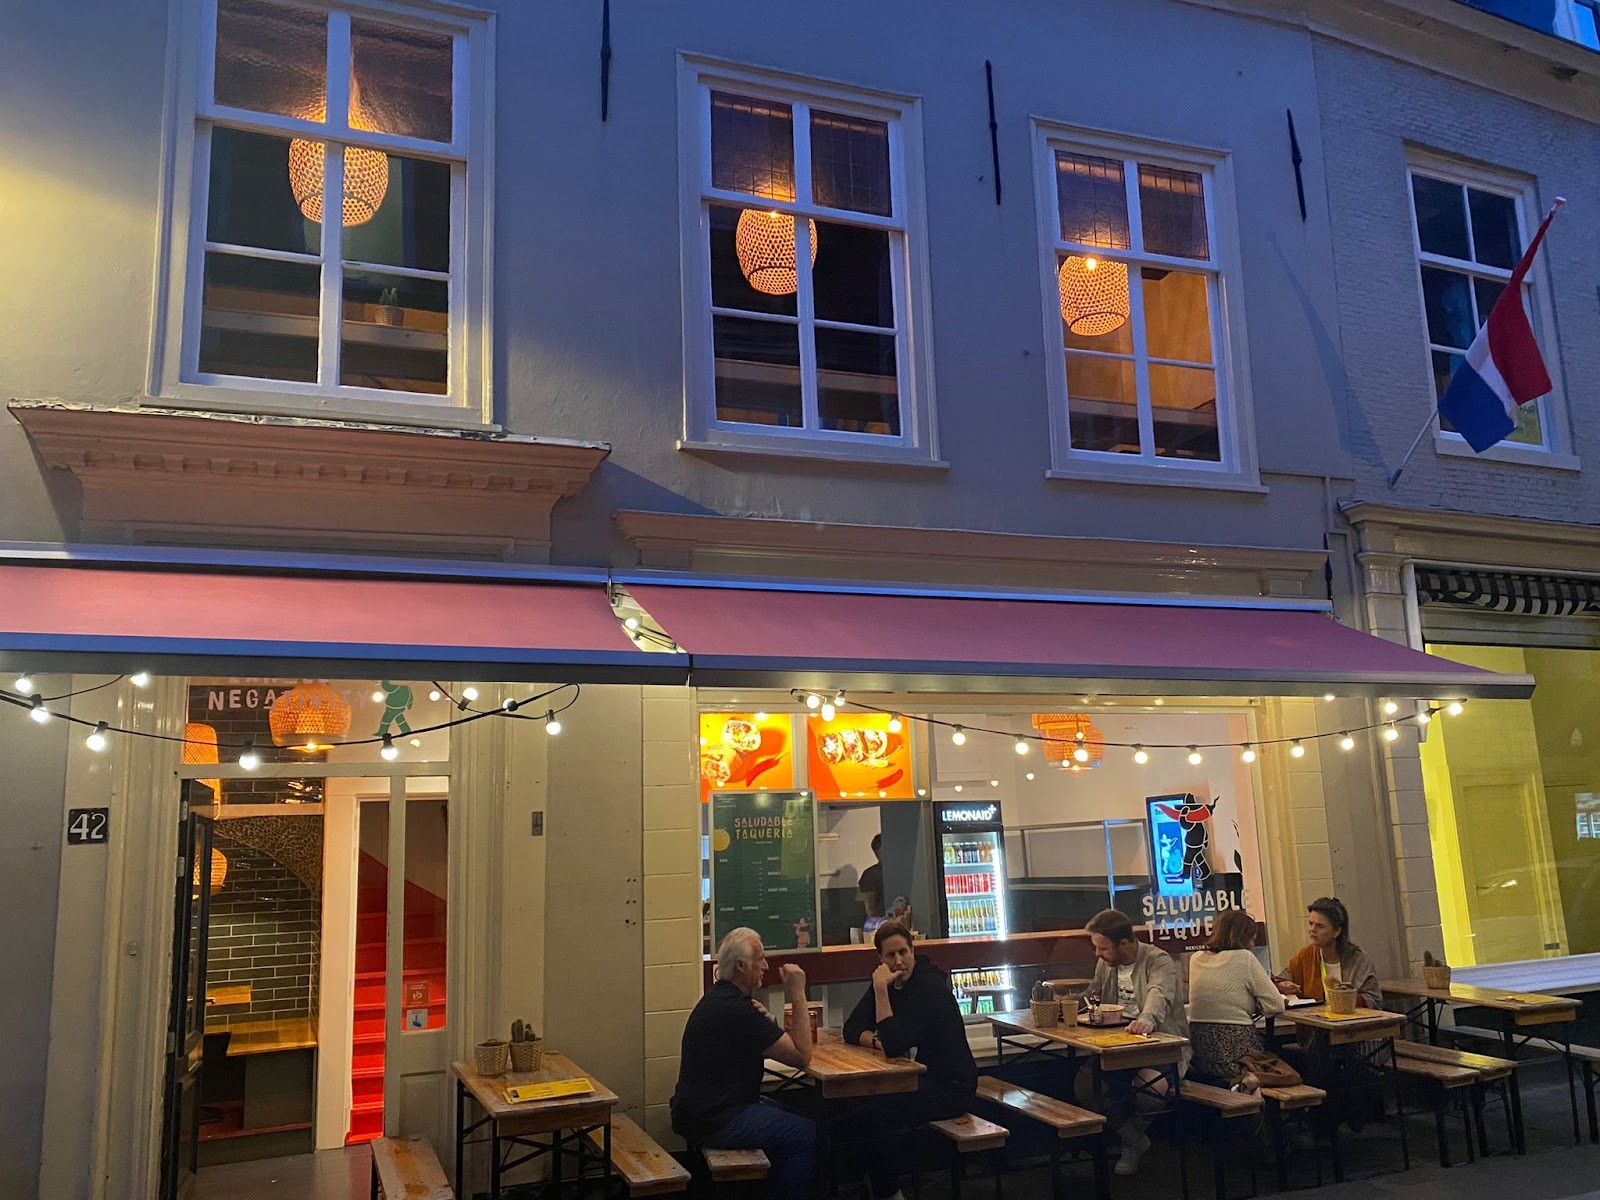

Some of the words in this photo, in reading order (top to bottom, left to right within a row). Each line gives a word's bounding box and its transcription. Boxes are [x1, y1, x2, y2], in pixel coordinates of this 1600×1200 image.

[69, 813, 106, 840] 42
[734, 816, 793, 828] SALUDABLE
[735, 828, 794, 840] TAQUERIA
[1145, 914, 1214, 943] TAQUE
